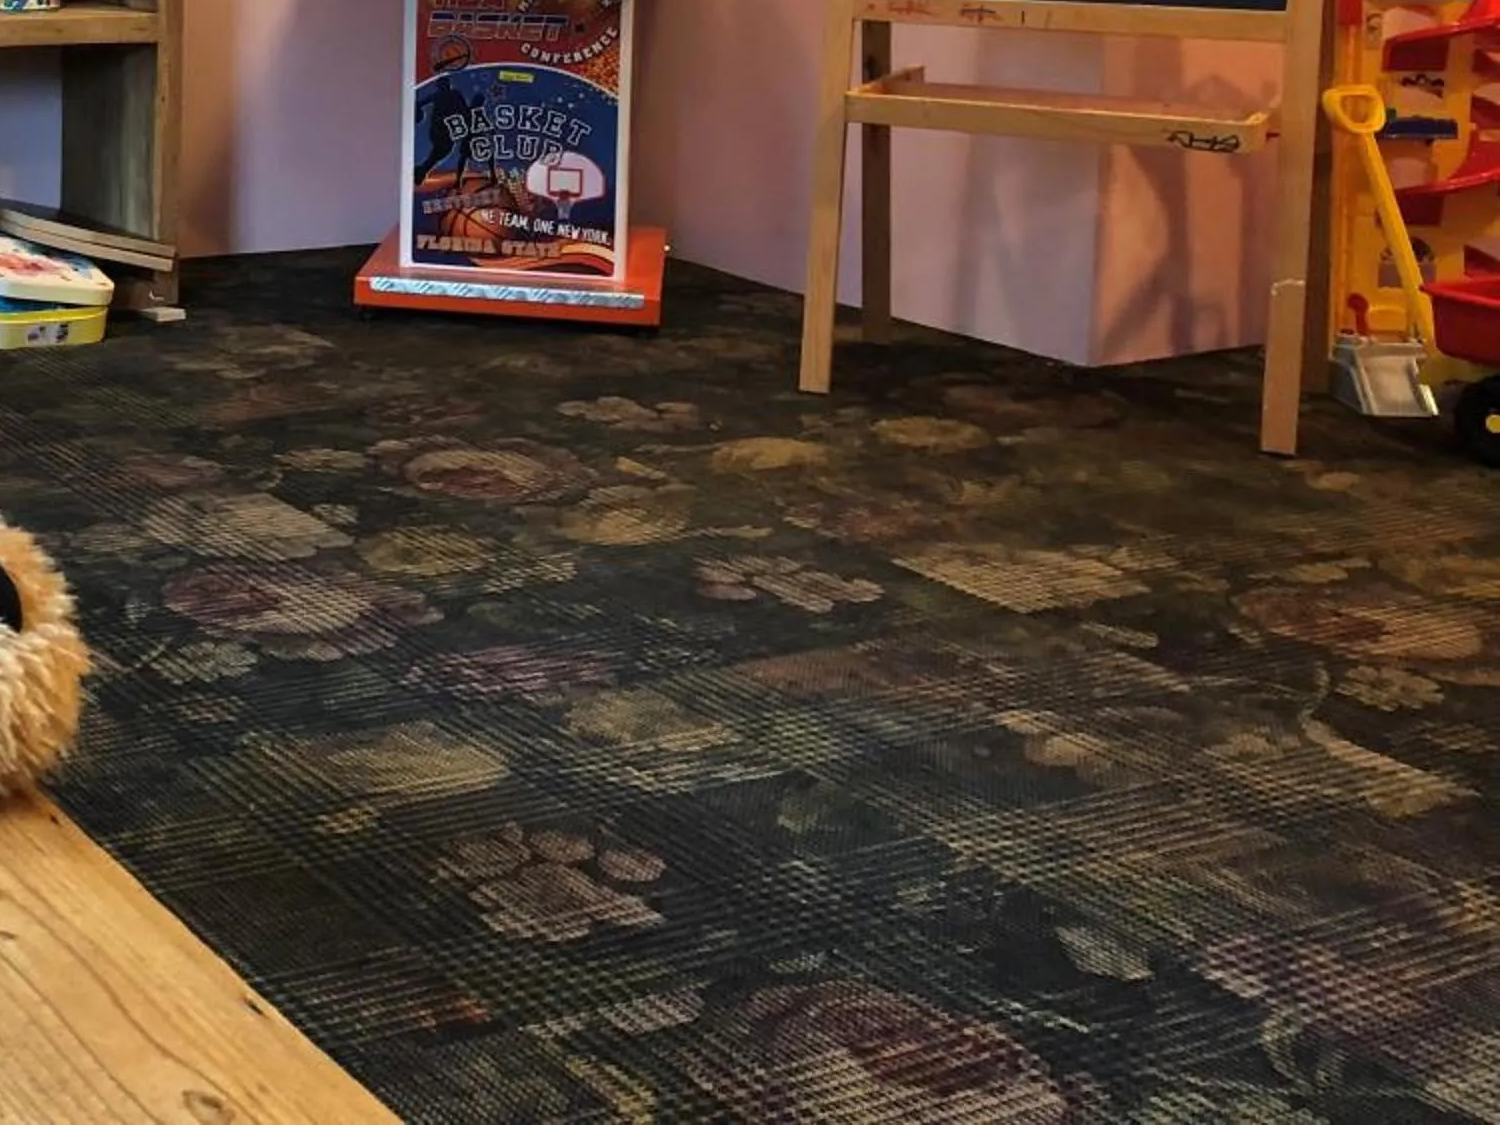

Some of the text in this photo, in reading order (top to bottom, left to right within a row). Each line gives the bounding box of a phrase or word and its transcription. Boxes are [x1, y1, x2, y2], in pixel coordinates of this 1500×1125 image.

[520, 26, 619, 65] CONFERENCE
[443, 104, 593, 147] BASKET
[469, 134, 564, 166] CLUB
[533, 217, 554, 236] ONE
[557, 223, 583, 240] NEW
